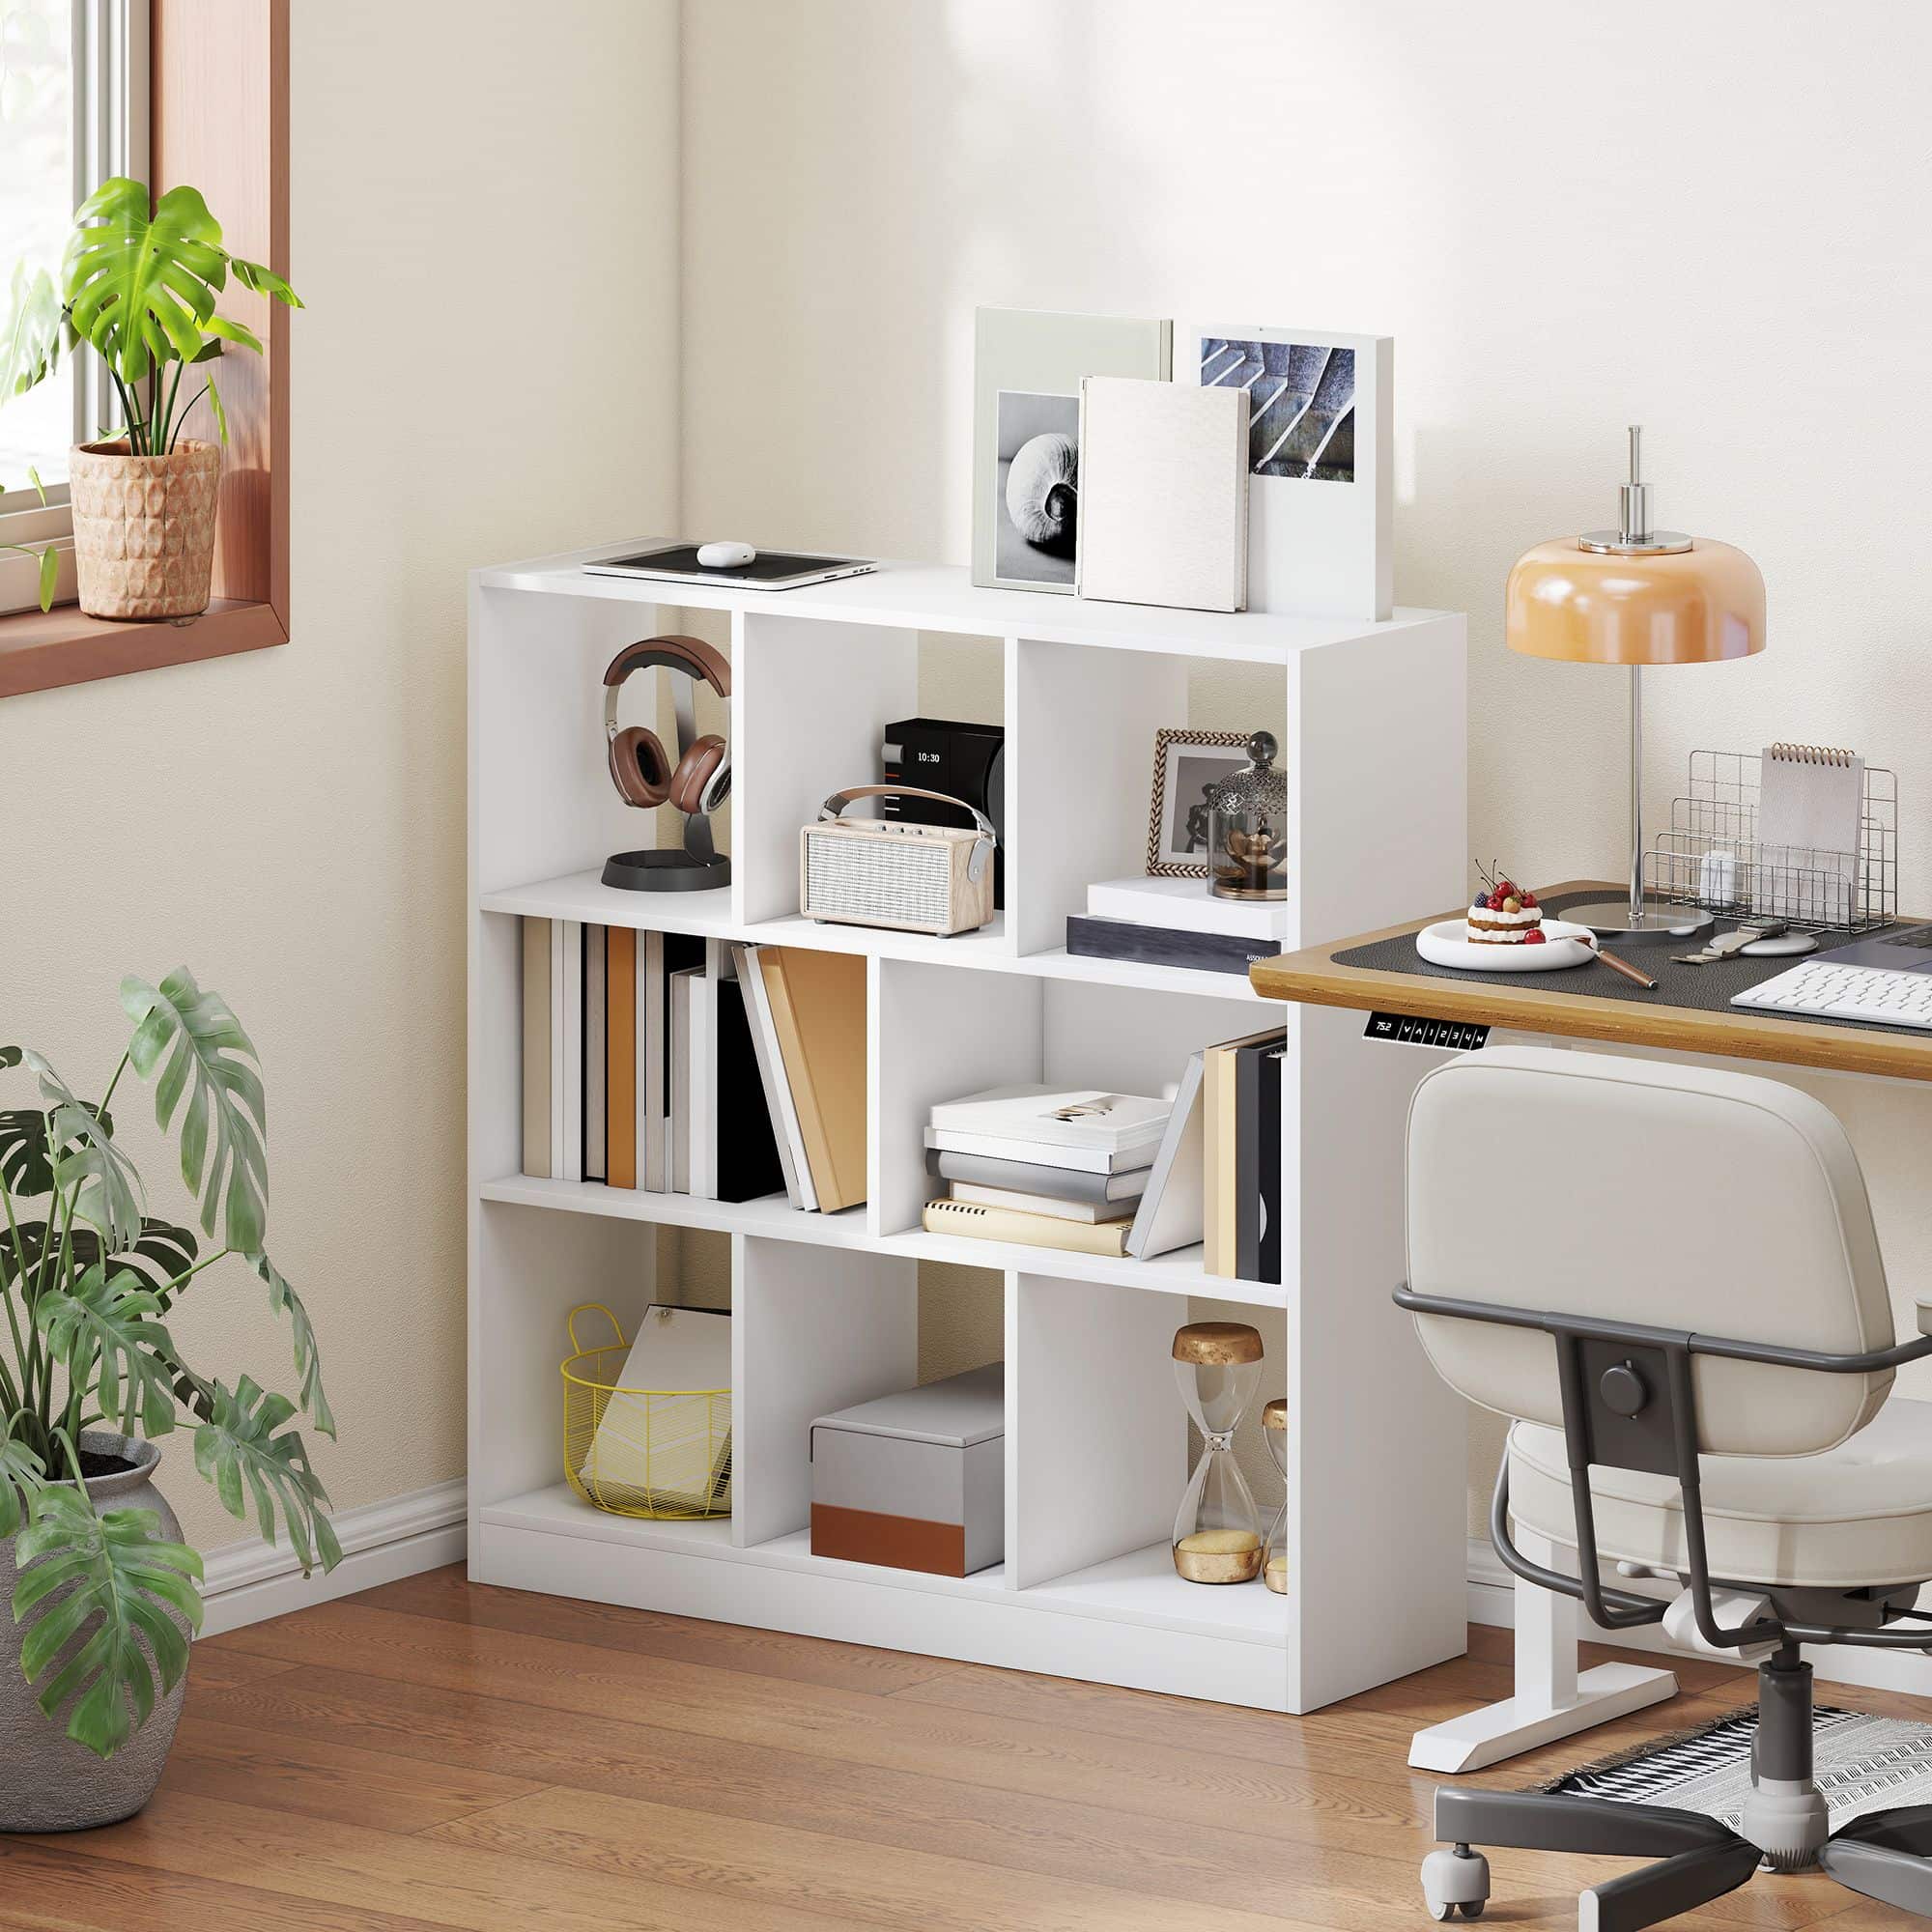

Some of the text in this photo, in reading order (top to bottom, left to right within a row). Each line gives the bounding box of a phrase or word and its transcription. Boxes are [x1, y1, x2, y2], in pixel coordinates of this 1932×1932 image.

[918, 752, 940, 763] 10:30
[1429, 1028, 1435, 1037] 1
[1439, 1030, 1447, 1038] 2
